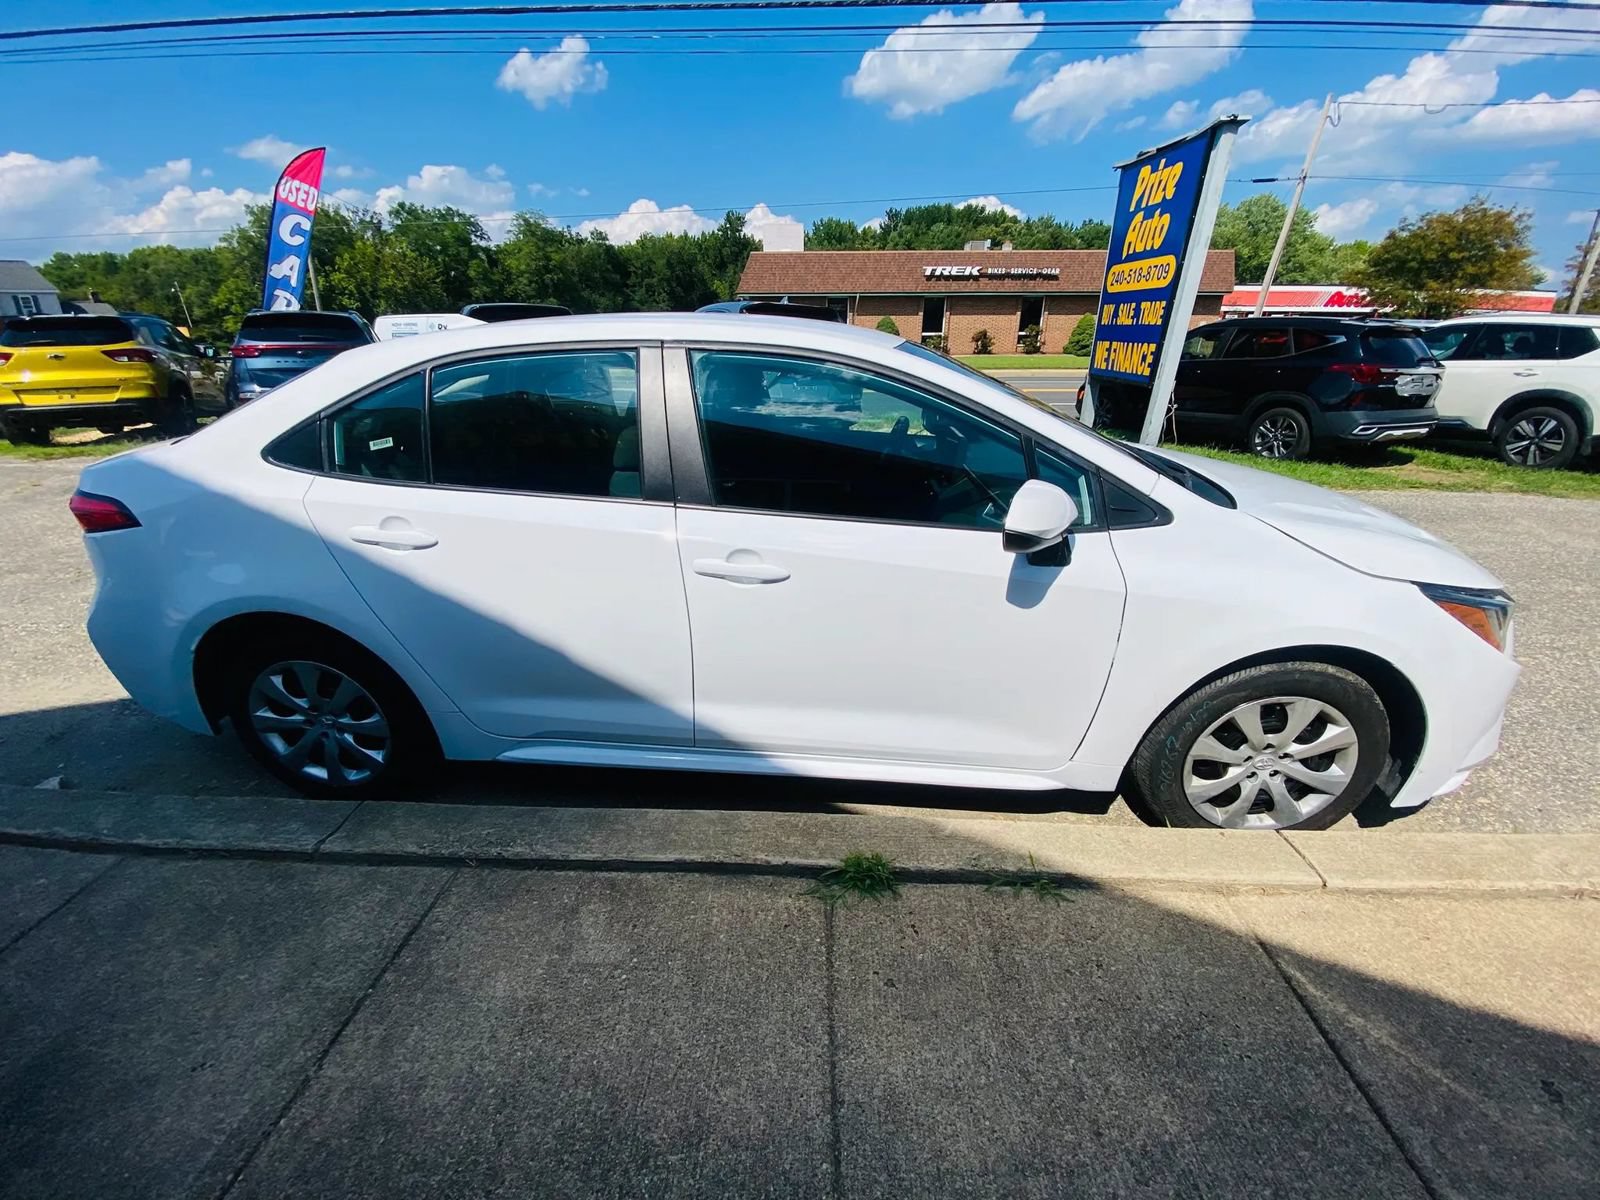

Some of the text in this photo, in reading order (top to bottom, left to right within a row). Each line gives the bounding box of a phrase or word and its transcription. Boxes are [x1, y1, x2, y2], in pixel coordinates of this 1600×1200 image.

[278, 175, 319, 212] USED
[1129, 158, 1184, 212] Prize
[1121, 207, 1171, 260] Auto
[923, 265, 983, 276] TREK
[1110, 262, 1171, 287] 240-518-8709
[1101, 301, 1166, 325] BUY SALE TRADE
[1094, 341, 1157, 376] WE FINANCE
